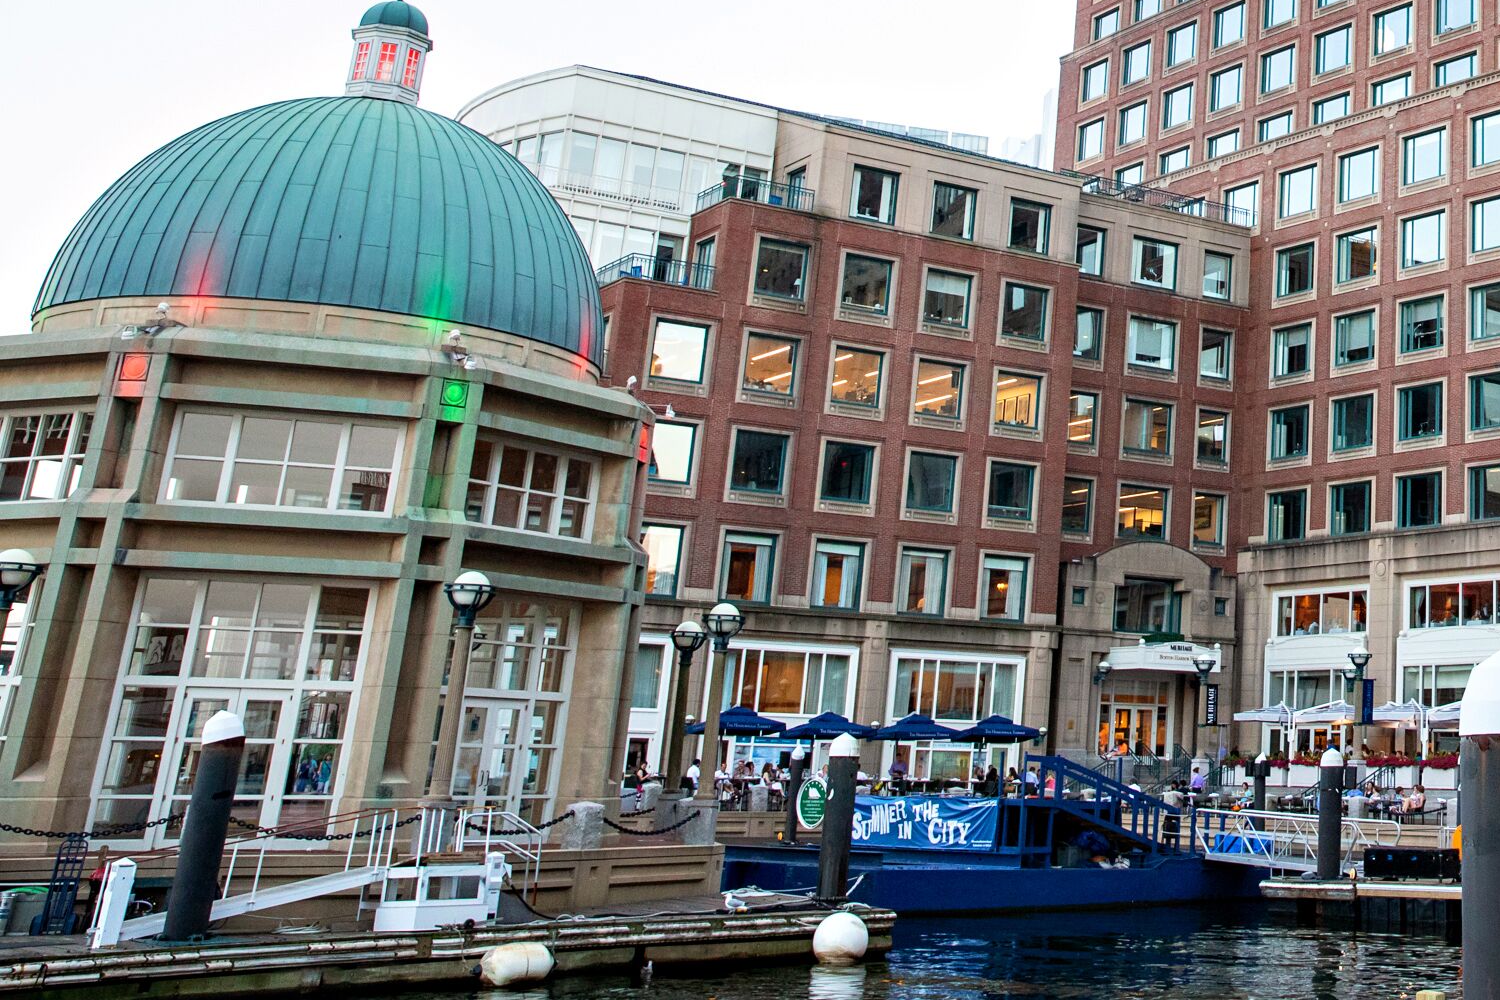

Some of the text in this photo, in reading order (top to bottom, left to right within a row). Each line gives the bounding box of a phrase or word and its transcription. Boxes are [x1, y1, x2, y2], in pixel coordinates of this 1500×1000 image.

[851, 800, 907, 840] SUMMER
[912, 800, 939, 822] THE
[898, 818, 971, 844] IN CITY
